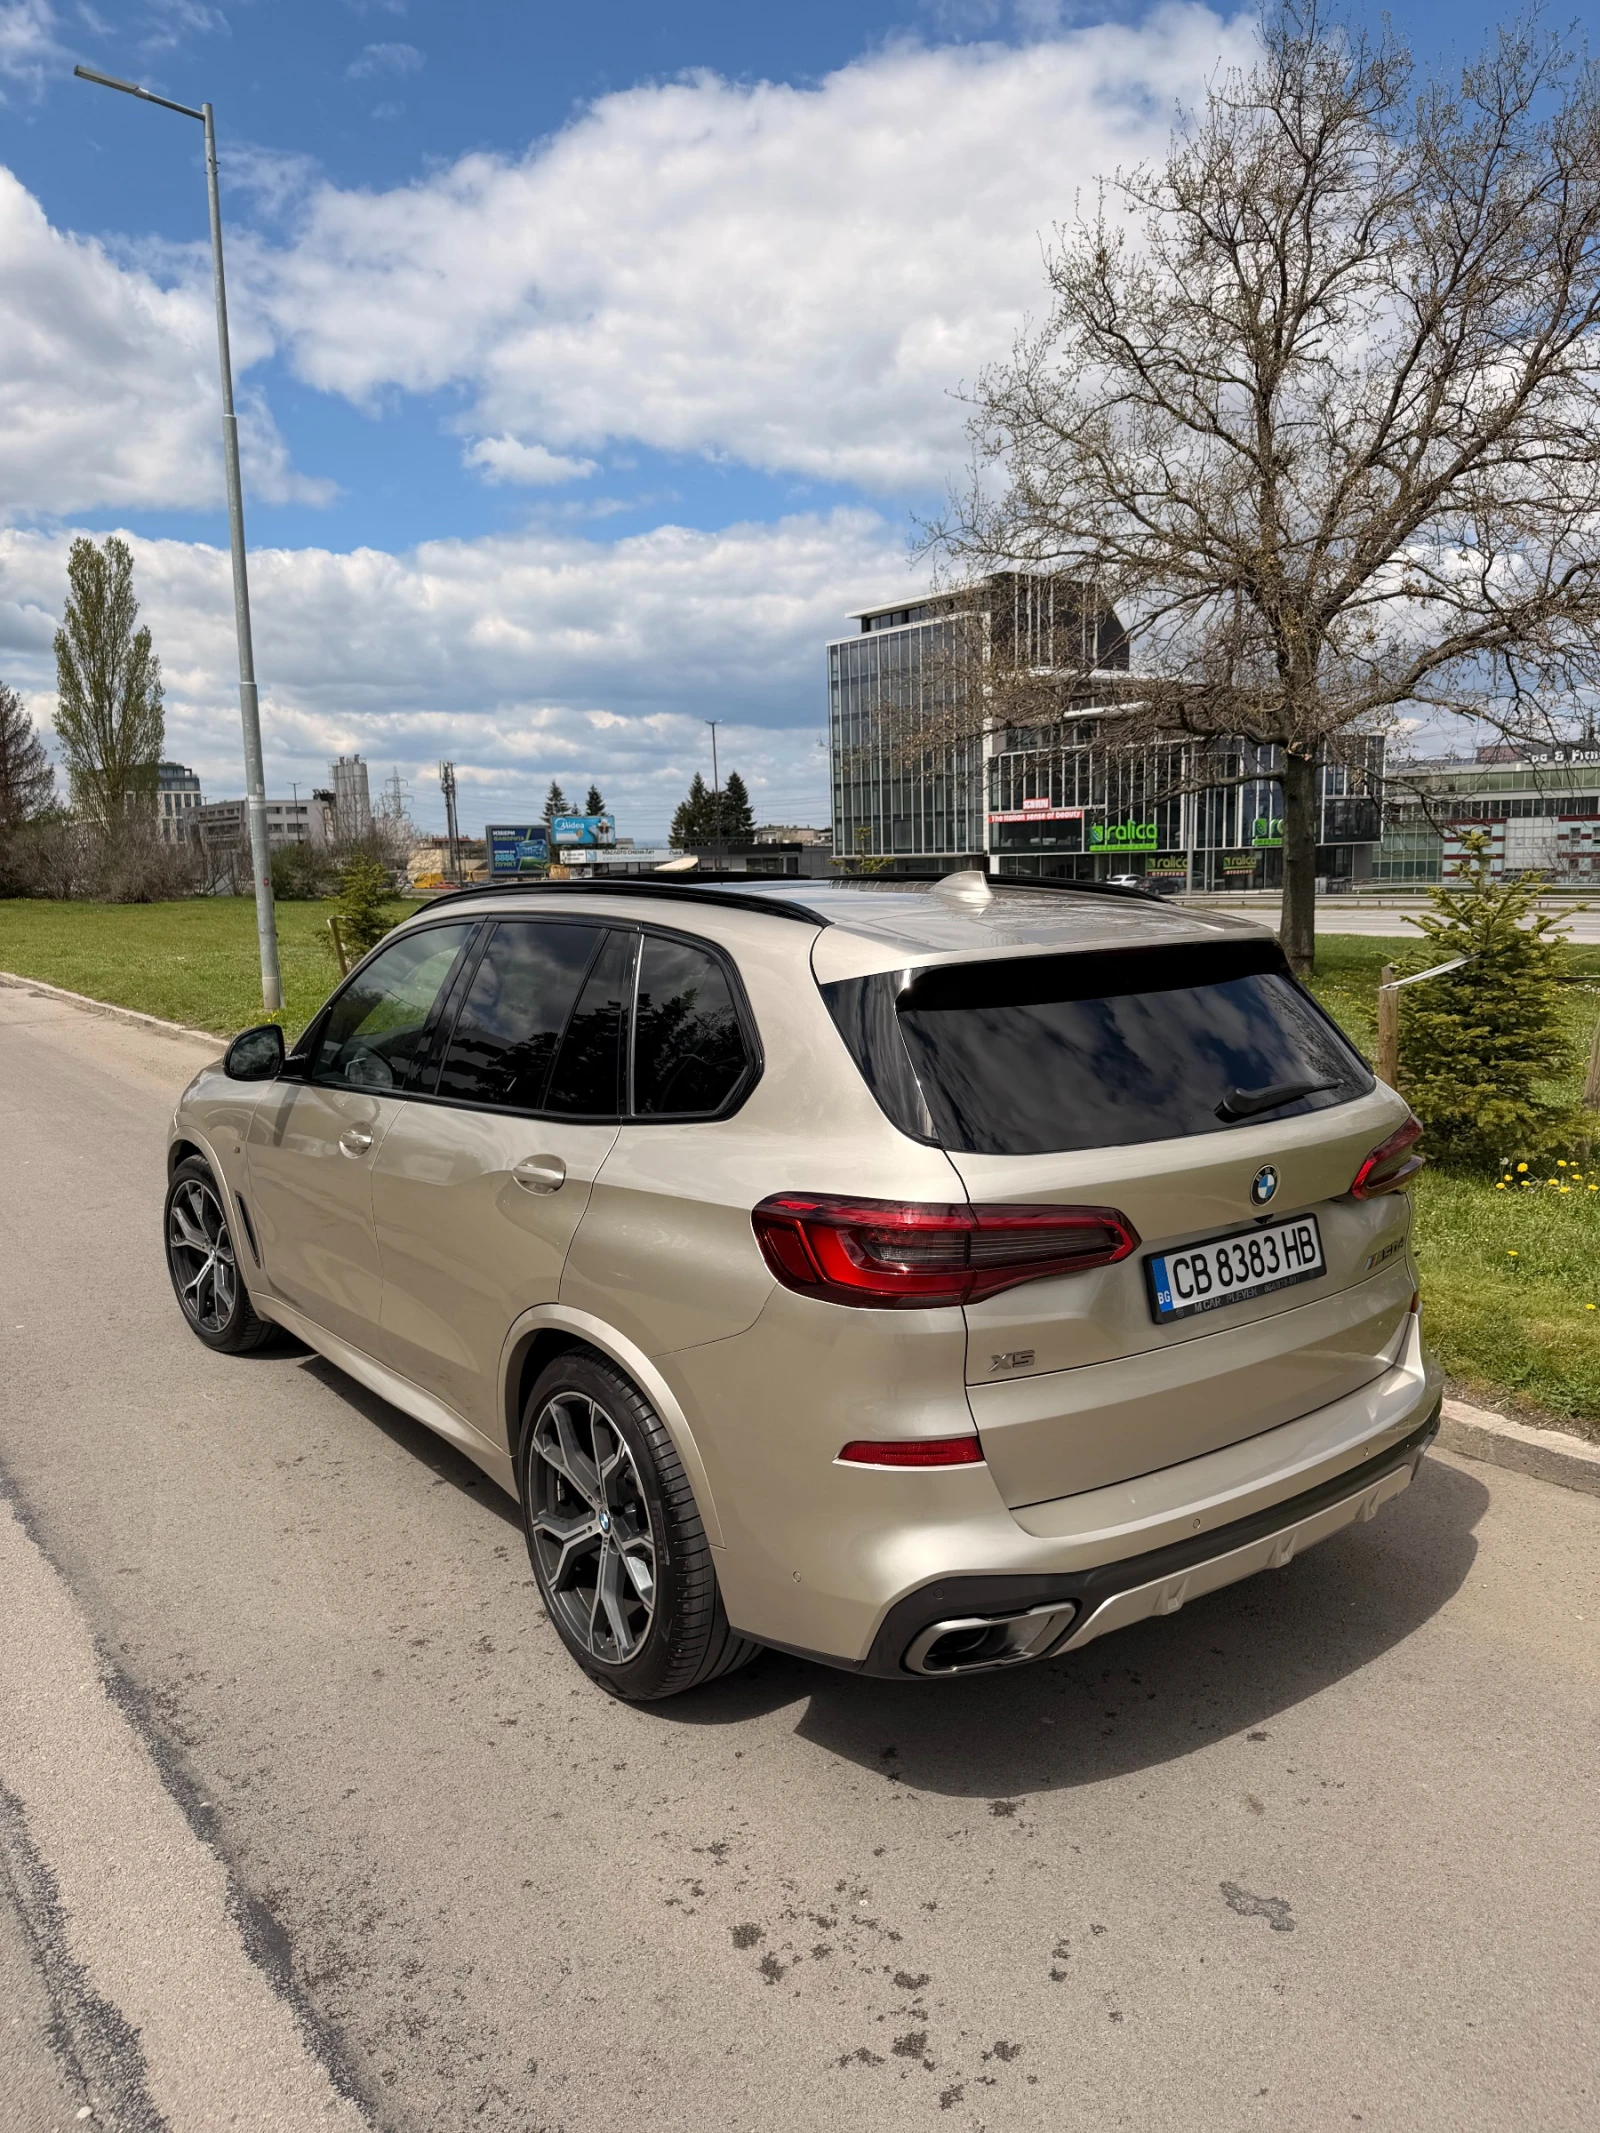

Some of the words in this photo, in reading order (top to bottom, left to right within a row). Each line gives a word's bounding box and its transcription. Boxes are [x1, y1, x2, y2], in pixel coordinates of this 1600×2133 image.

[1026, 812, 1046, 821] sense
[1105, 819, 1158, 840] ralica
[1157, 855, 1188, 868] ralica
[1231, 854, 1257, 866] ralica
[1173, 1254, 1213, 1299] CB
[1217, 1235, 1280, 1287] 8383
[1281, 1225, 1316, 1271] HB
[1157, 1290, 1171, 1304] BG
[1227, 1287, 1258, 1303] PLEVEN
[988, 1349, 1035, 1372] X5
